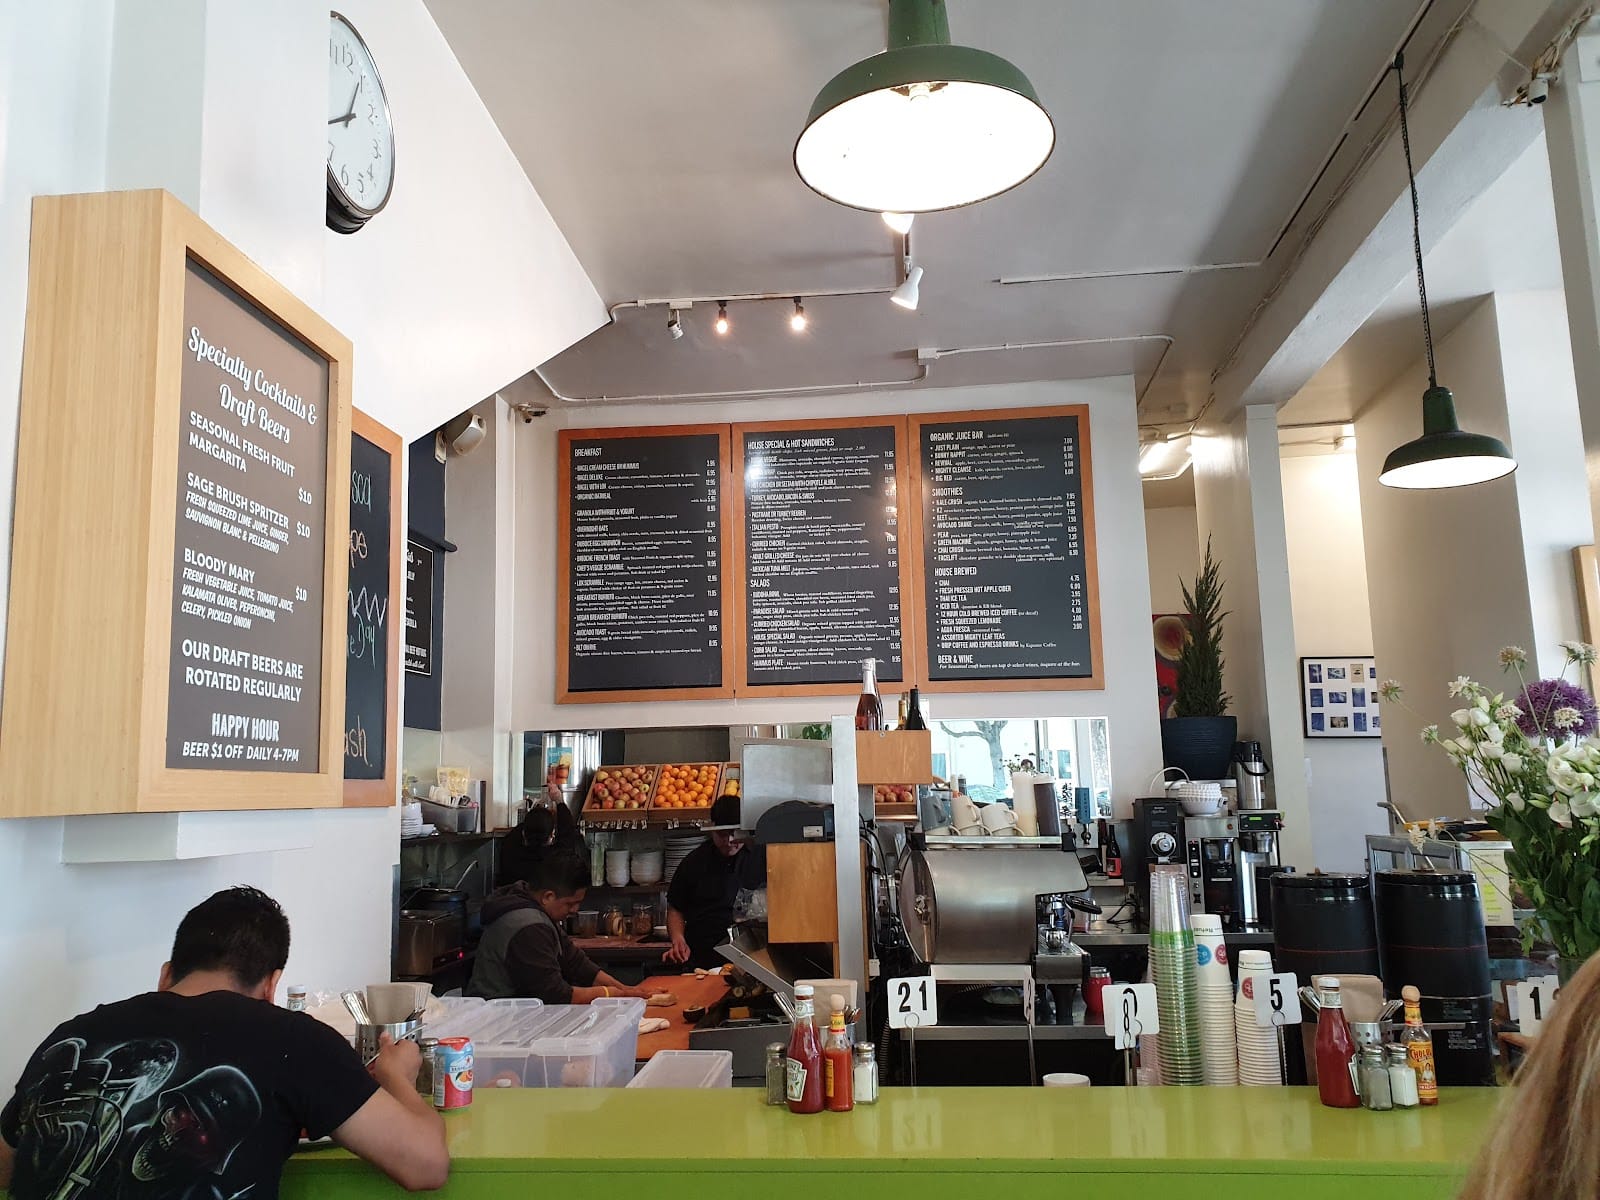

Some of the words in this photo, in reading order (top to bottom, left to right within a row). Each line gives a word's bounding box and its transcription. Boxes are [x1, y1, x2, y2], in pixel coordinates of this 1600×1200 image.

[188, 326, 252, 391] Specialty
[255, 369, 307, 420] Cocktails
[307, 403, 318, 425] &
[219, 384, 257, 427] Draft
[257, 406, 291, 444] Beers
[189, 411, 241, 449] SEASONAL
[243, 439, 270, 465] FRESH
[271, 453, 296, 478] FRUIT
[574, 447, 603, 457] BREAKFAST
[747, 440, 764, 450] HOUSE
[765, 439, 785, 449] SPECIAL
[786, 439, 790, 448] &
[791, 438, 801, 448] HOT
[801, 437, 835, 447] SANDWICHES
[930, 431, 954, 442] ORGANIC
[955, 431, 972, 440] JUICE
[972, 430, 984, 439] BAR
[189, 432, 247, 473] MARGARITA
[298, 487, 312, 505] $10
[187, 472, 214, 496] SAGE
[216, 484, 248, 511] BRUSH
[250, 500, 289, 529] SPRITZER
[297, 521, 311, 538] $10
[932, 487, 963, 496] SMOOTHIES
[185, 507, 222, 532] SAUVIGNON
[222, 519, 242, 540] BLANC
[242, 527, 248, 542] &
[248, 530, 280, 555] PELLEGRINO
[186, 490, 207, 509] FRESH
[208, 499, 237, 521] SQUEEZED
[238, 511, 252, 527] LIME
[252, 517, 269, 536] JUICE,
[269, 524, 290, 545] GINGER,
[183, 568, 204, 584] FRESH
[205, 572, 238, 594] VEGETABLE
[238, 582, 256, 601] JUICE,
[256, 590, 279, 607] TOMATO
[184, 548, 227, 574] BLOODY
[228, 563, 255, 584] MARY
[295, 585, 307, 602] $10
[750, 578, 770, 588] SALADS
[934, 567, 953, 577] HOUSE
[954, 566, 977, 576] BREWED
[181, 601, 207, 620] CELERY,
[206, 608, 233, 626] PICKLED
[233, 615, 252, 630] ONION
[182, 584, 216, 605] KALAMATA
[216, 595, 238, 613] OLIVES,
[239, 601, 276, 622] PEPERONCINI,
[182, 639, 210, 660] OUR
[213, 646, 250, 669] DRAFT
[252, 655, 283, 676] BEERS
[284, 663, 304, 680] ARE
[938, 654, 952, 664] BEER
[953, 654, 958, 663] &
[958, 654, 973, 663] WINE
[185, 667, 241, 692] ROTATED
[243, 678, 302, 703] REGULARLY
[211, 713, 250, 737] HAPPY
[251, 720, 280, 742] HOUR
[182, 742, 210, 758] BEER
[211, 743, 223, 759] $1
[224, 744, 244, 758] OFF
[246, 745, 273, 761] DAILY
[273, 747, 300, 762] 4-7PM
[897, 980, 928, 1012] 21
[1269, 979, 1283, 1011] 5
[1123, 998, 1130, 1031] 8
